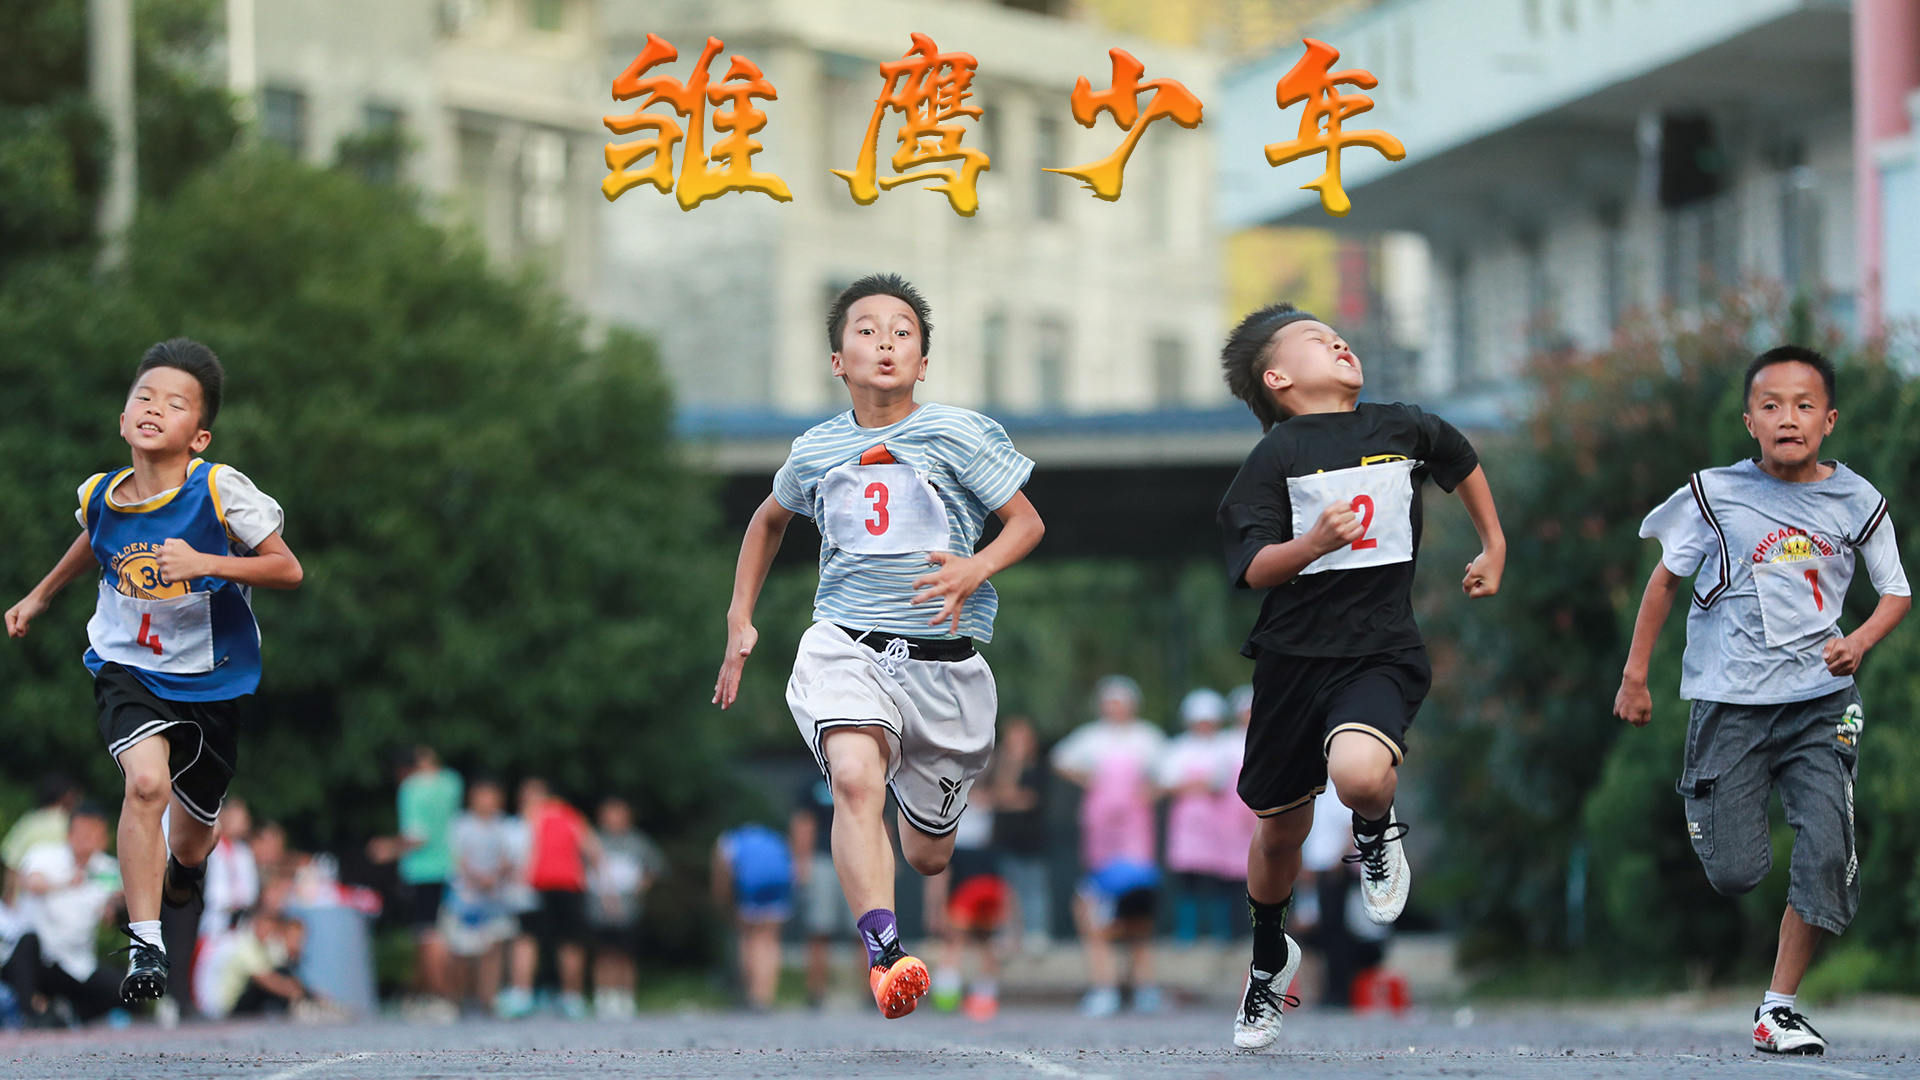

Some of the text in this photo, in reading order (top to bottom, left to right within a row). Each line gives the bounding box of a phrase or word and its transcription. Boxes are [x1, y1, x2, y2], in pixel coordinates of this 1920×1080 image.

[864, 482, 890, 536] 3
[1350, 494, 1377, 551] 2
[111, 542, 148, 570] GOLDEN
[1804, 569, 1823, 612] 1
[136, 613, 163, 656] 4
